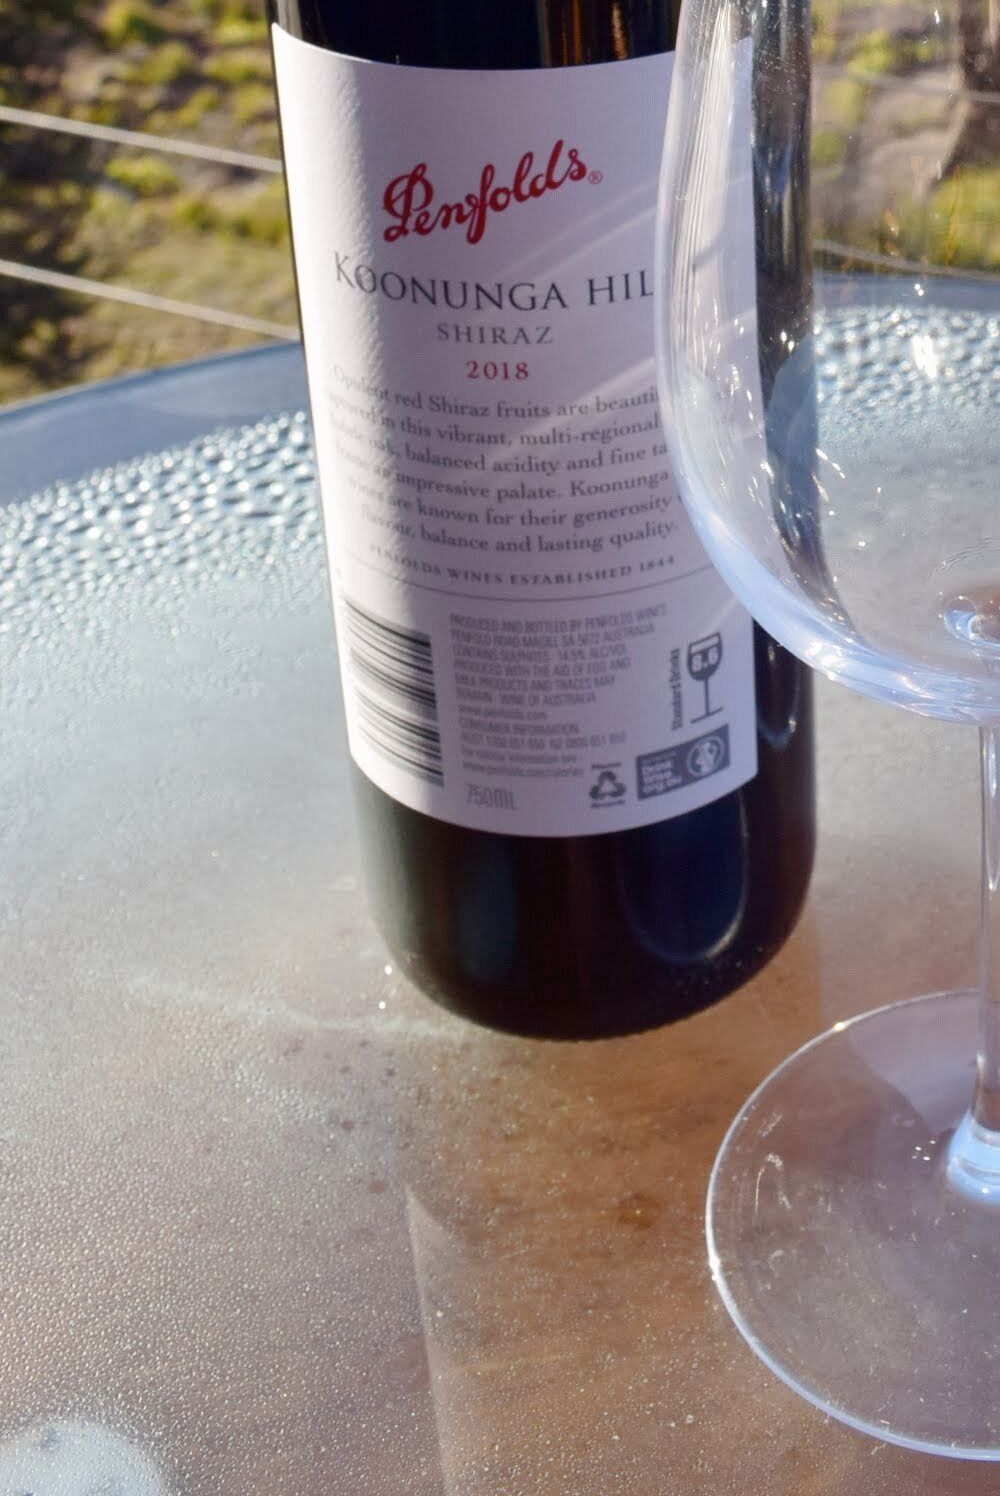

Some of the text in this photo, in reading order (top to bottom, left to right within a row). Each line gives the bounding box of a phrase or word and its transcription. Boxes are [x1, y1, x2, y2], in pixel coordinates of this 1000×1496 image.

[383, 139, 587, 245] Penfolds
[335, 251, 654, 311] KOONUNGA HIL
[437, 324, 553, 345] SHIRAZ
[467, 360, 529, 381] 2018
[395, 392, 422, 409] red
[429, 394, 489, 417] Shiraz
[497, 401, 549, 418] fruits
[557, 403, 589, 416] are
[596, 385, 659, 413] beauti
[401, 416, 431, 438] this
[437, 423, 512, 447] vibrant,
[520, 410, 659, 445] multi-regional
[405, 442, 485, 471] balanced
[493, 455, 560, 476] acidity
[567, 449, 603, 471] and
[610, 447, 646, 465] fine
[396, 470, 489, 498] impressive
[497, 482, 563, 504] palate.
[571, 471, 668, 498] Koonunga
[417, 498, 478, 524] known
[486, 507, 513, 525] for
[521, 508, 567, 526] their
[573, 495, 672, 528] generosity
[421, 524, 489, 551] balance
[496, 535, 531, 553] and
[539, 535, 603, 552] lasting
[447, 567, 502, 585] WINES
[510, 564, 631, 585] ESTABLISHED
